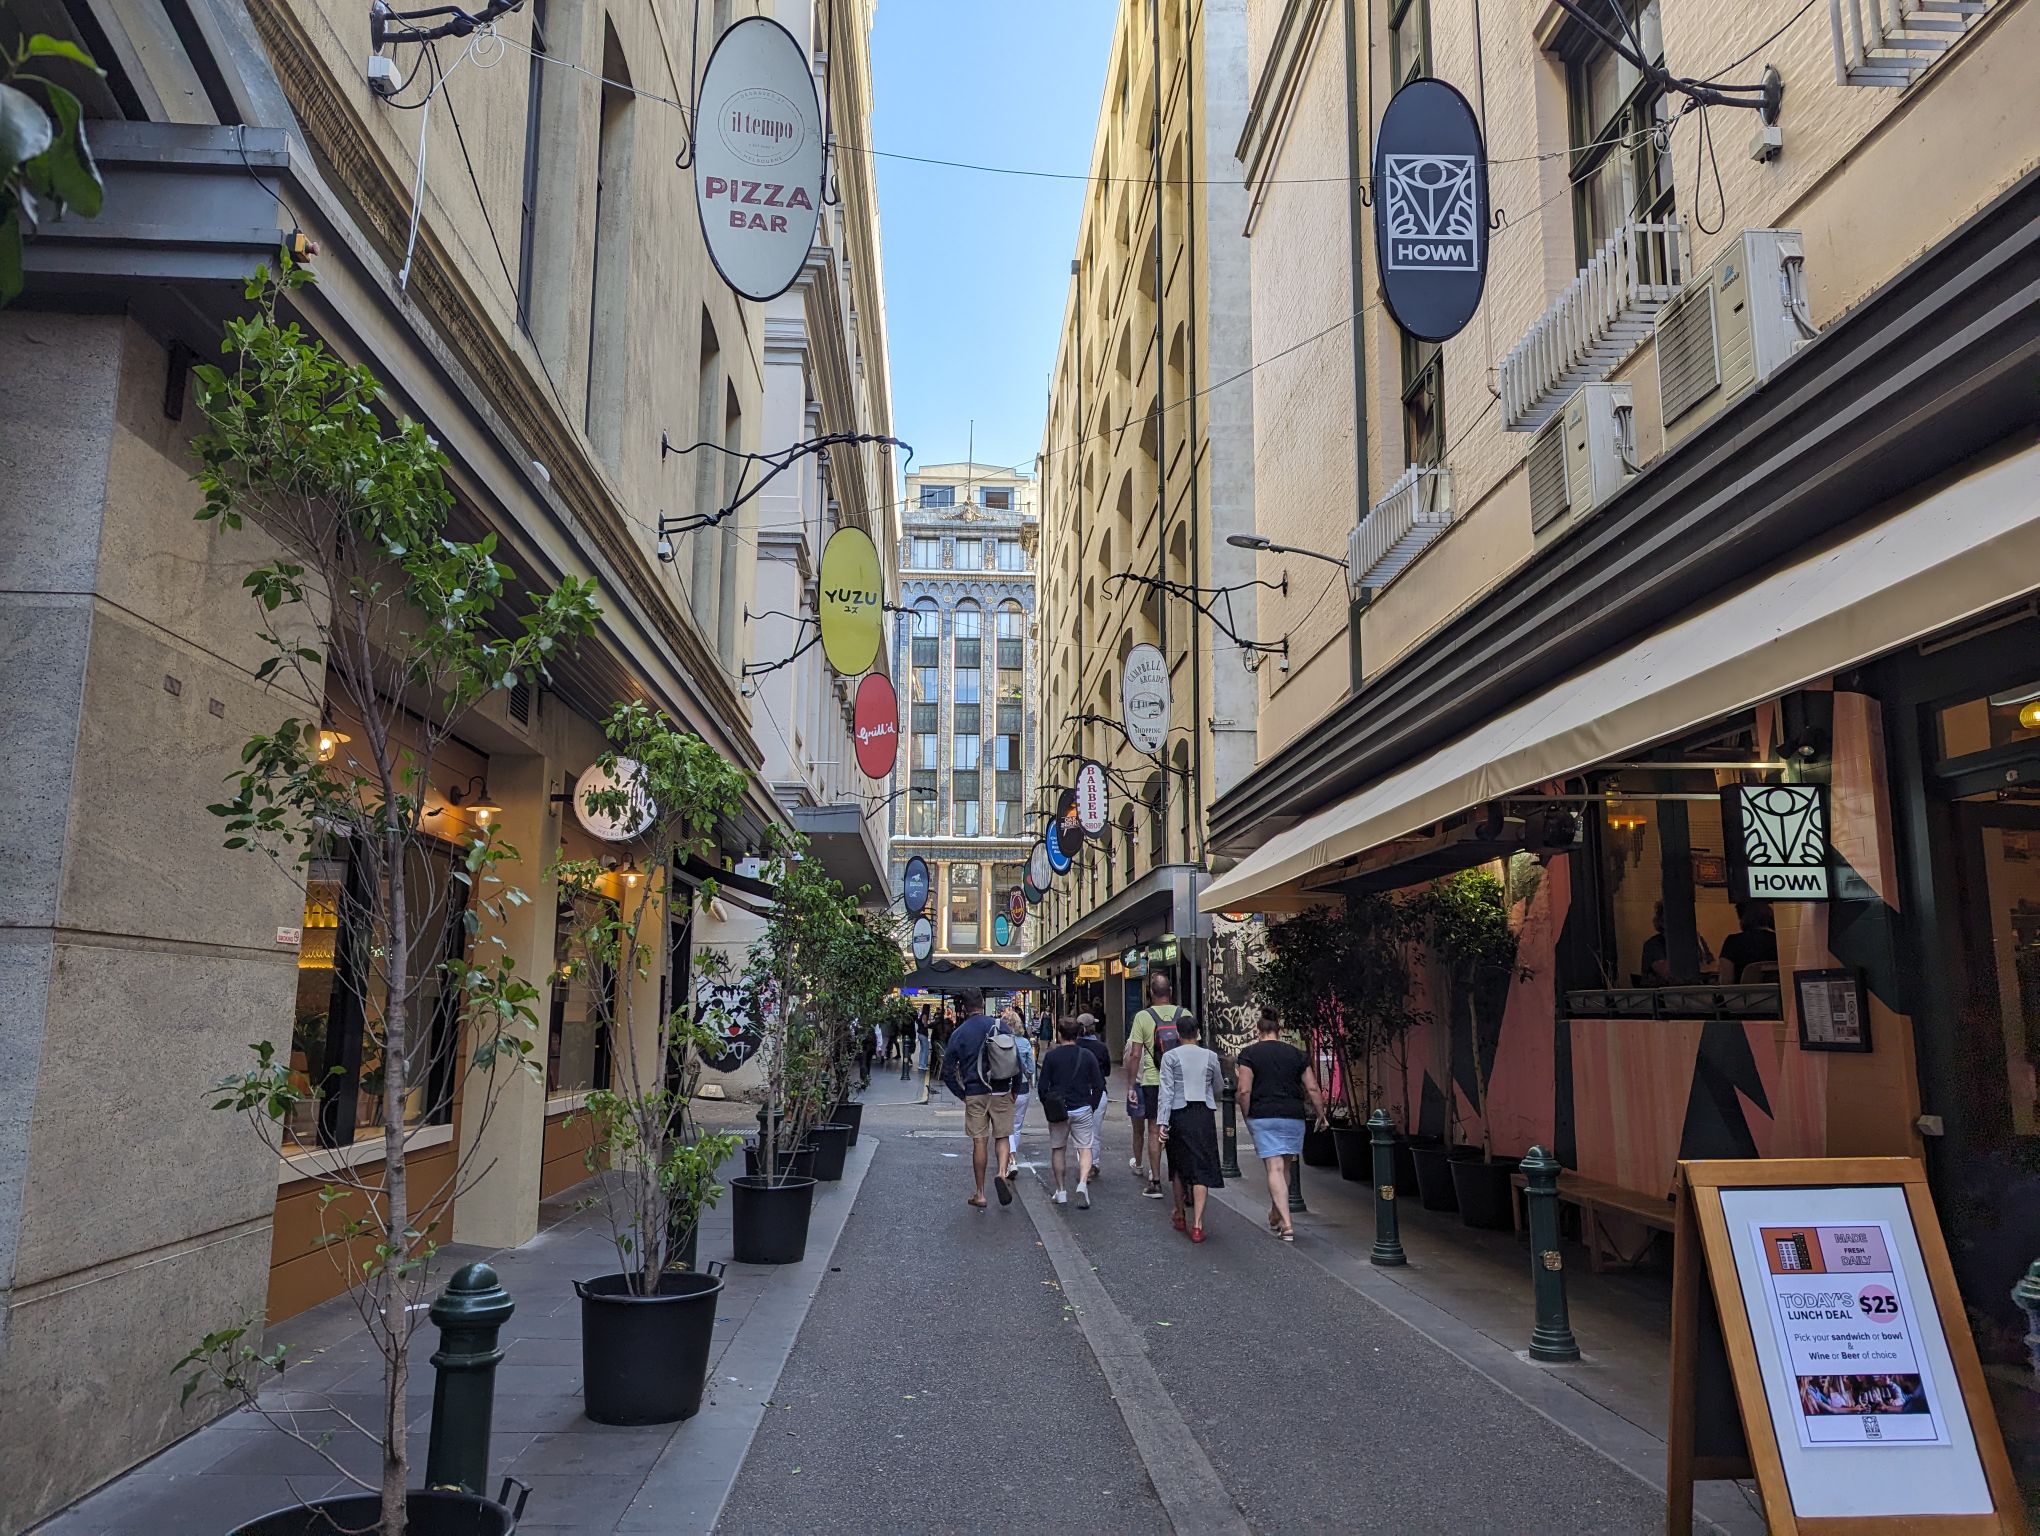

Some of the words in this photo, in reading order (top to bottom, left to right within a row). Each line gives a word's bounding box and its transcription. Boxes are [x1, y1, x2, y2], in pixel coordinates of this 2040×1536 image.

[732, 111, 742, 132] il
[745, 112, 793, 143] tempo
[705, 176, 814, 210] PIZZA
[730, 210, 787, 233] BAR
[825, 588, 878, 606] YUZU
[1127, 660, 1161, 683] CAMPBELL
[1139, 674, 1166, 685] ARCADE
[856, 722, 897, 746] Grill'd
[1087, 767, 1098, 819] BARBER
[1084, 822, 1103, 830] SHOP
[1833, 1233, 1868, 1244] MADE
[1841, 1255, 1872, 1266] DAILY
[1780, 1292, 1855, 1309] TODAY'S
[1859, 1295, 1899, 1315] $25
[1787, 1310, 1823, 1320] LUNCH
[1825, 1309, 1853, 1319] DEAL
[1794, 1333, 1811, 1341] Pick
[1812, 1334, 1829, 1343] your
[1831, 1332, 1871, 1341] sandwich
[1882, 1331, 1903, 1340] bowl
[1847, 1342, 1854, 1350] &
[1808, 1351, 1830, 1360] Wine
[1831, 1352, 1839, 1360] or
[1841, 1351, 1861, 1360] Beer
[1862, 1351, 1870, 1359] of
[1871, 1351, 1897, 1360] choice
